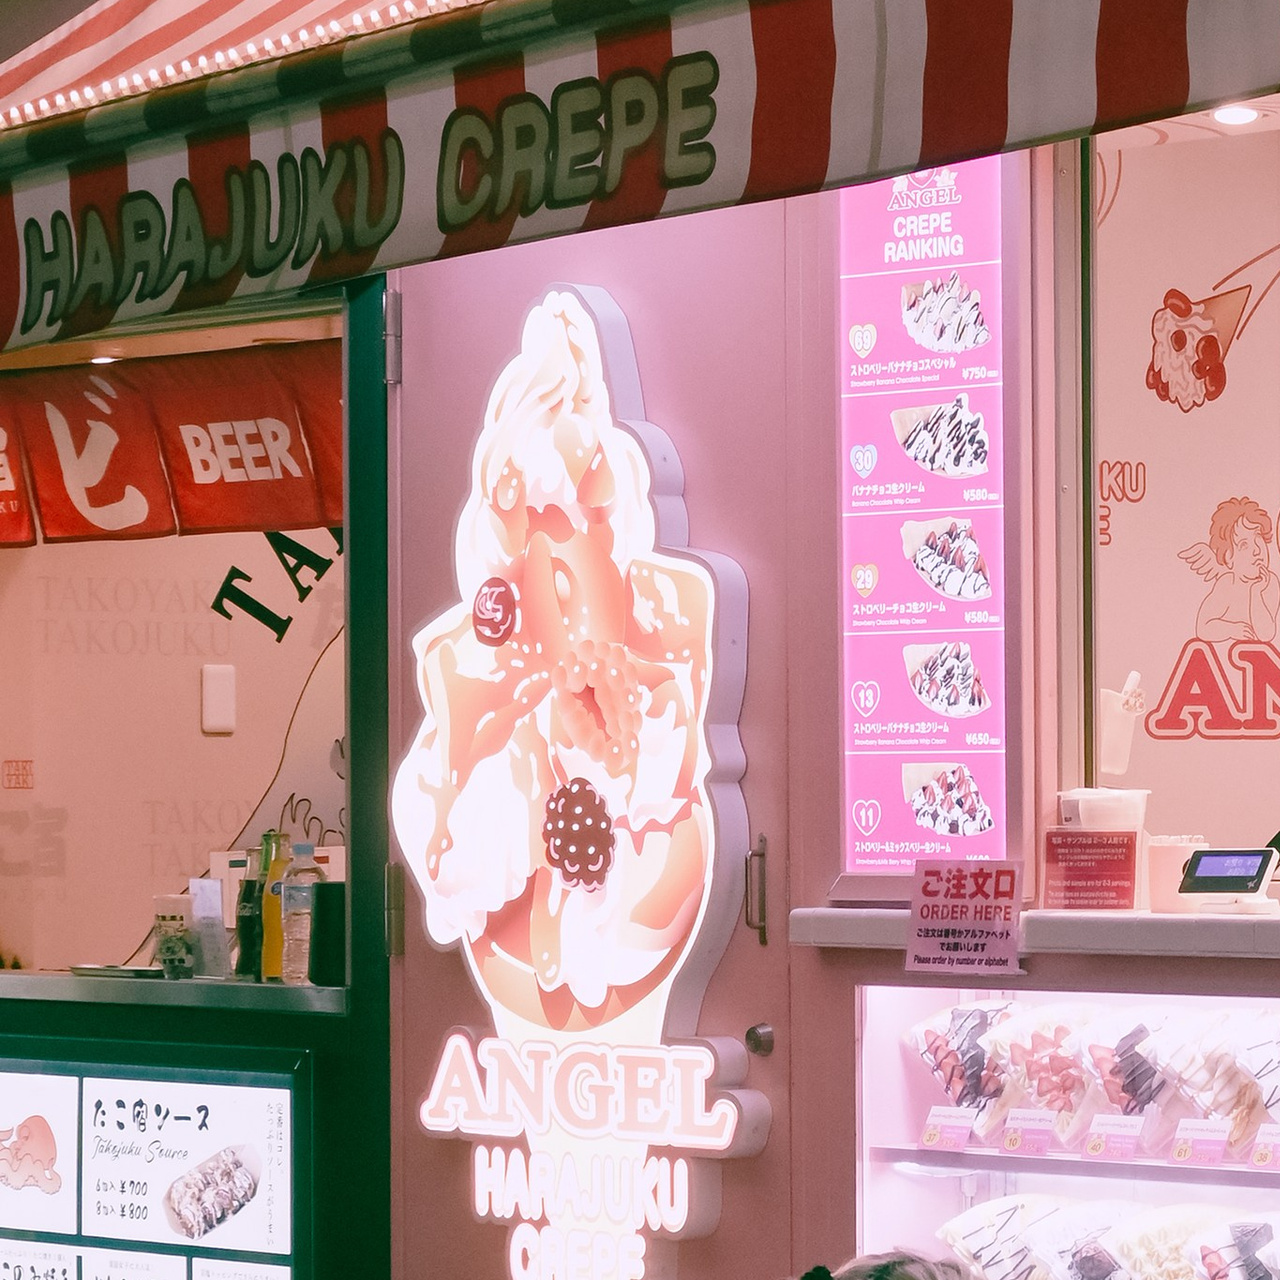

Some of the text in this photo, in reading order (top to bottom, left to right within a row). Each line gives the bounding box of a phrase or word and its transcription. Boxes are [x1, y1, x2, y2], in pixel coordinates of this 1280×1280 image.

[21, 50, 720, 336] HARAJUKU CREPE
[887, 186, 962, 211] ANGEL
[893, 211, 952, 238] CREPE
[884, 234, 964, 263] RANKING
[44, 375, 149, 529] ビ
[179, 417, 303, 485] BEER
[855, 450, 873, 472] 30
[856, 570, 873, 589] 29
[858, 688, 874, 708] 13
[859, 807, 874, 827] 11
[921, 867, 1016, 900] ご注文口
[920, 904, 1012, 921] ORDER HERE
[917, 927, 1011, 940] ご注文は番号かアルファベット
[939, 942, 987, 953] でお願いします
[913, 954, 930, 965] Please
[932, 955, 947, 965] order
[948, 957, 955, 966] by
[955, 957, 976, 966] number
[984, 957, 1009, 967] alphabet
[421, 1034, 738, 1150] ANGEL
[93, 1098, 210, 1132] たこ宿ソース
[92, 1135, 189, 1163] Takojuku Source
[1008, 1135, 1018, 1147] 10
[120, 1180, 148, 1196] ¥700
[474, 1145, 689, 1233] HARAJUKU
[120, 1204, 148, 1220] ¥800
